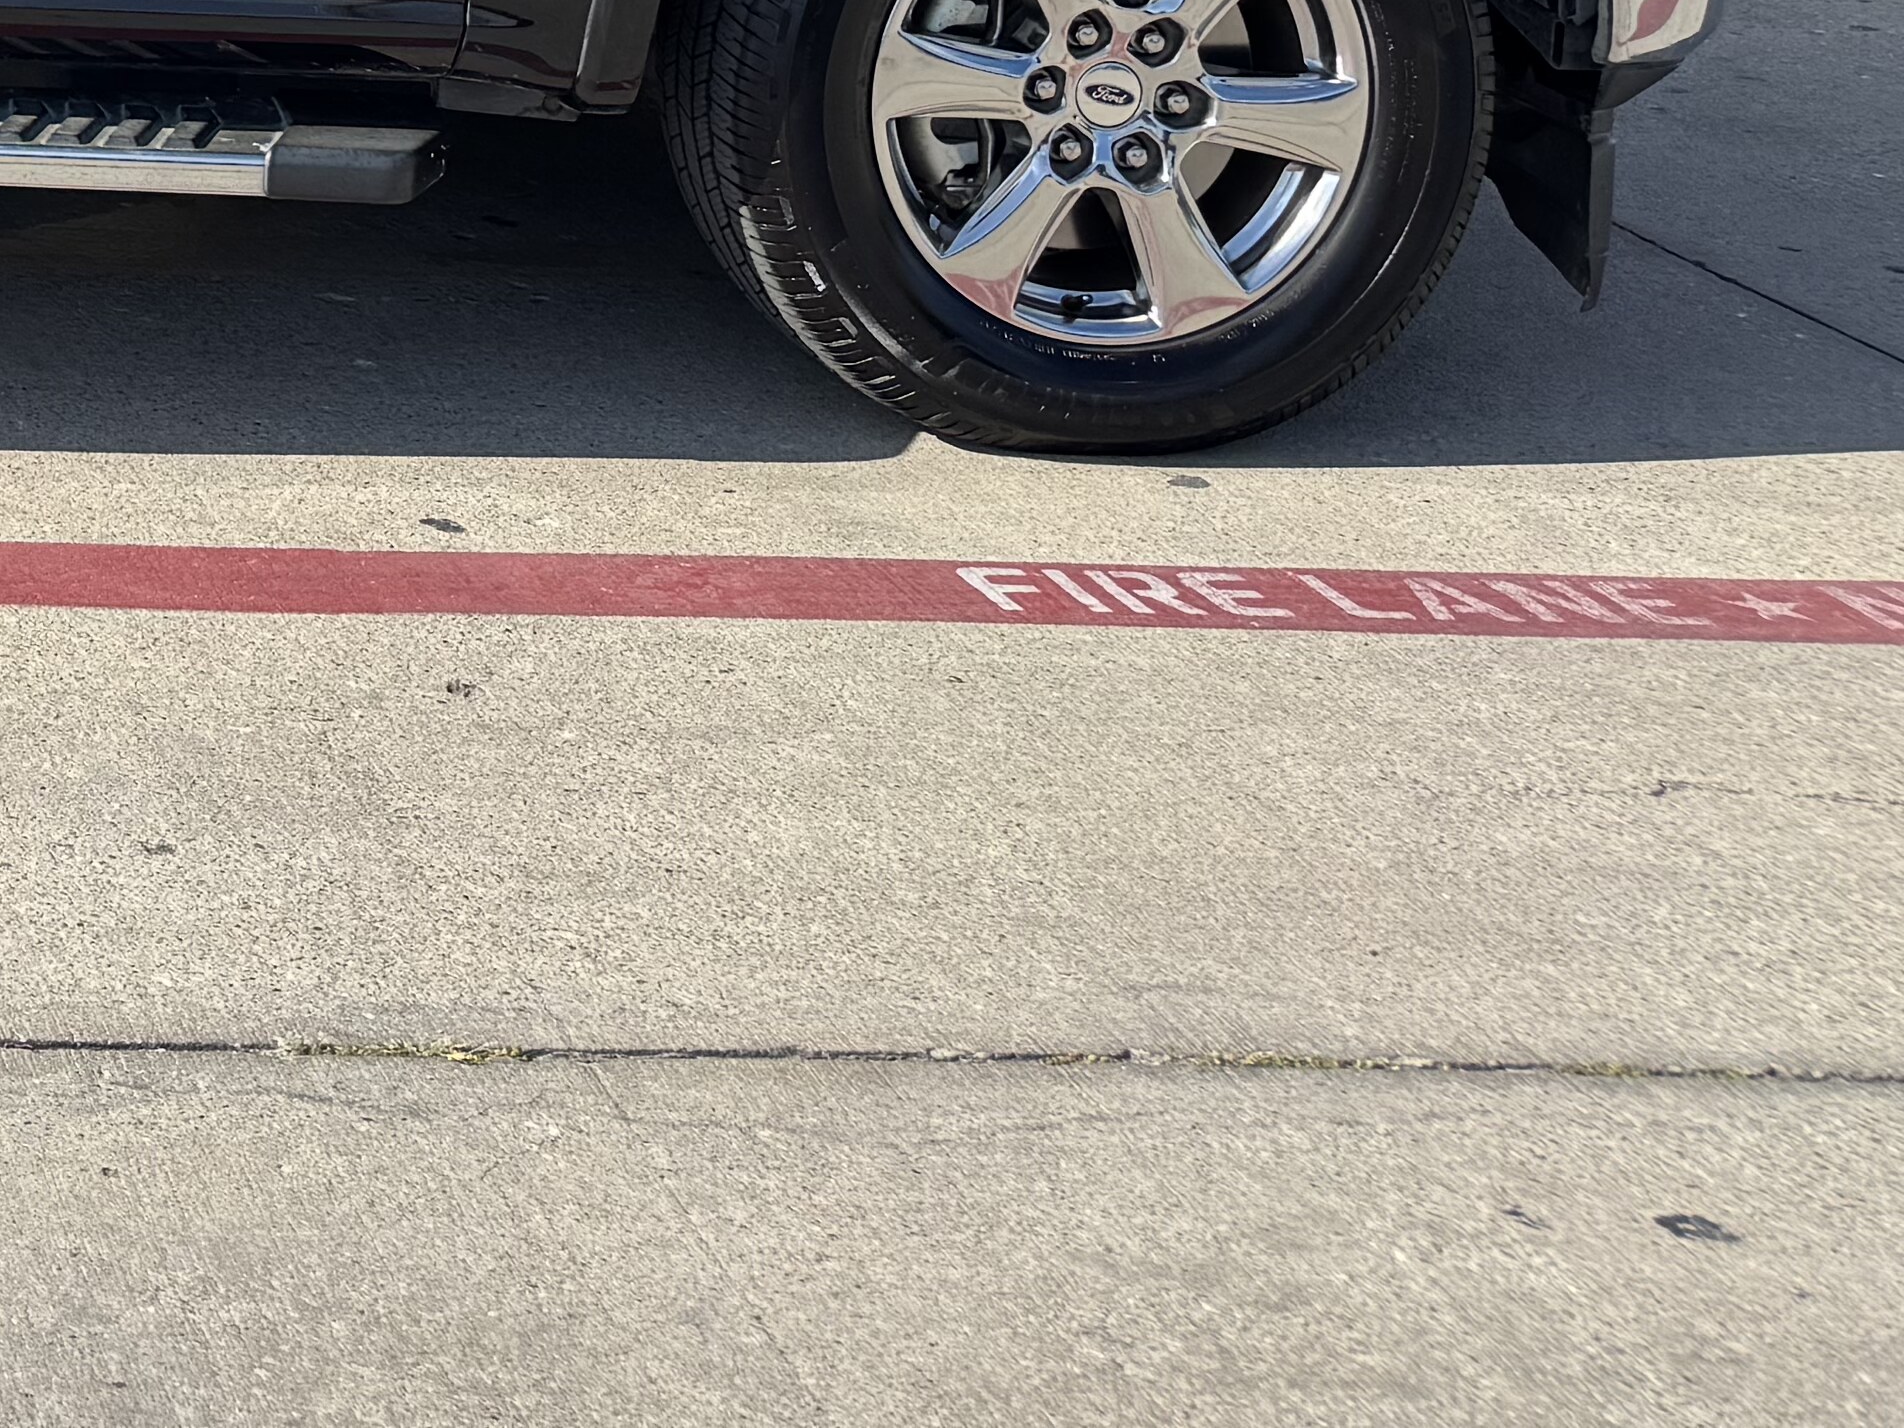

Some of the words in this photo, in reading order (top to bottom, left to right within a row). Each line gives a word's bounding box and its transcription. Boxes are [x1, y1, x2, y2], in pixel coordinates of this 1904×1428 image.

[1092, 85, 1130, 105] Ford
[956, 566, 1296, 618] FIRE
[1296, 573, 1714, 626] LANE
